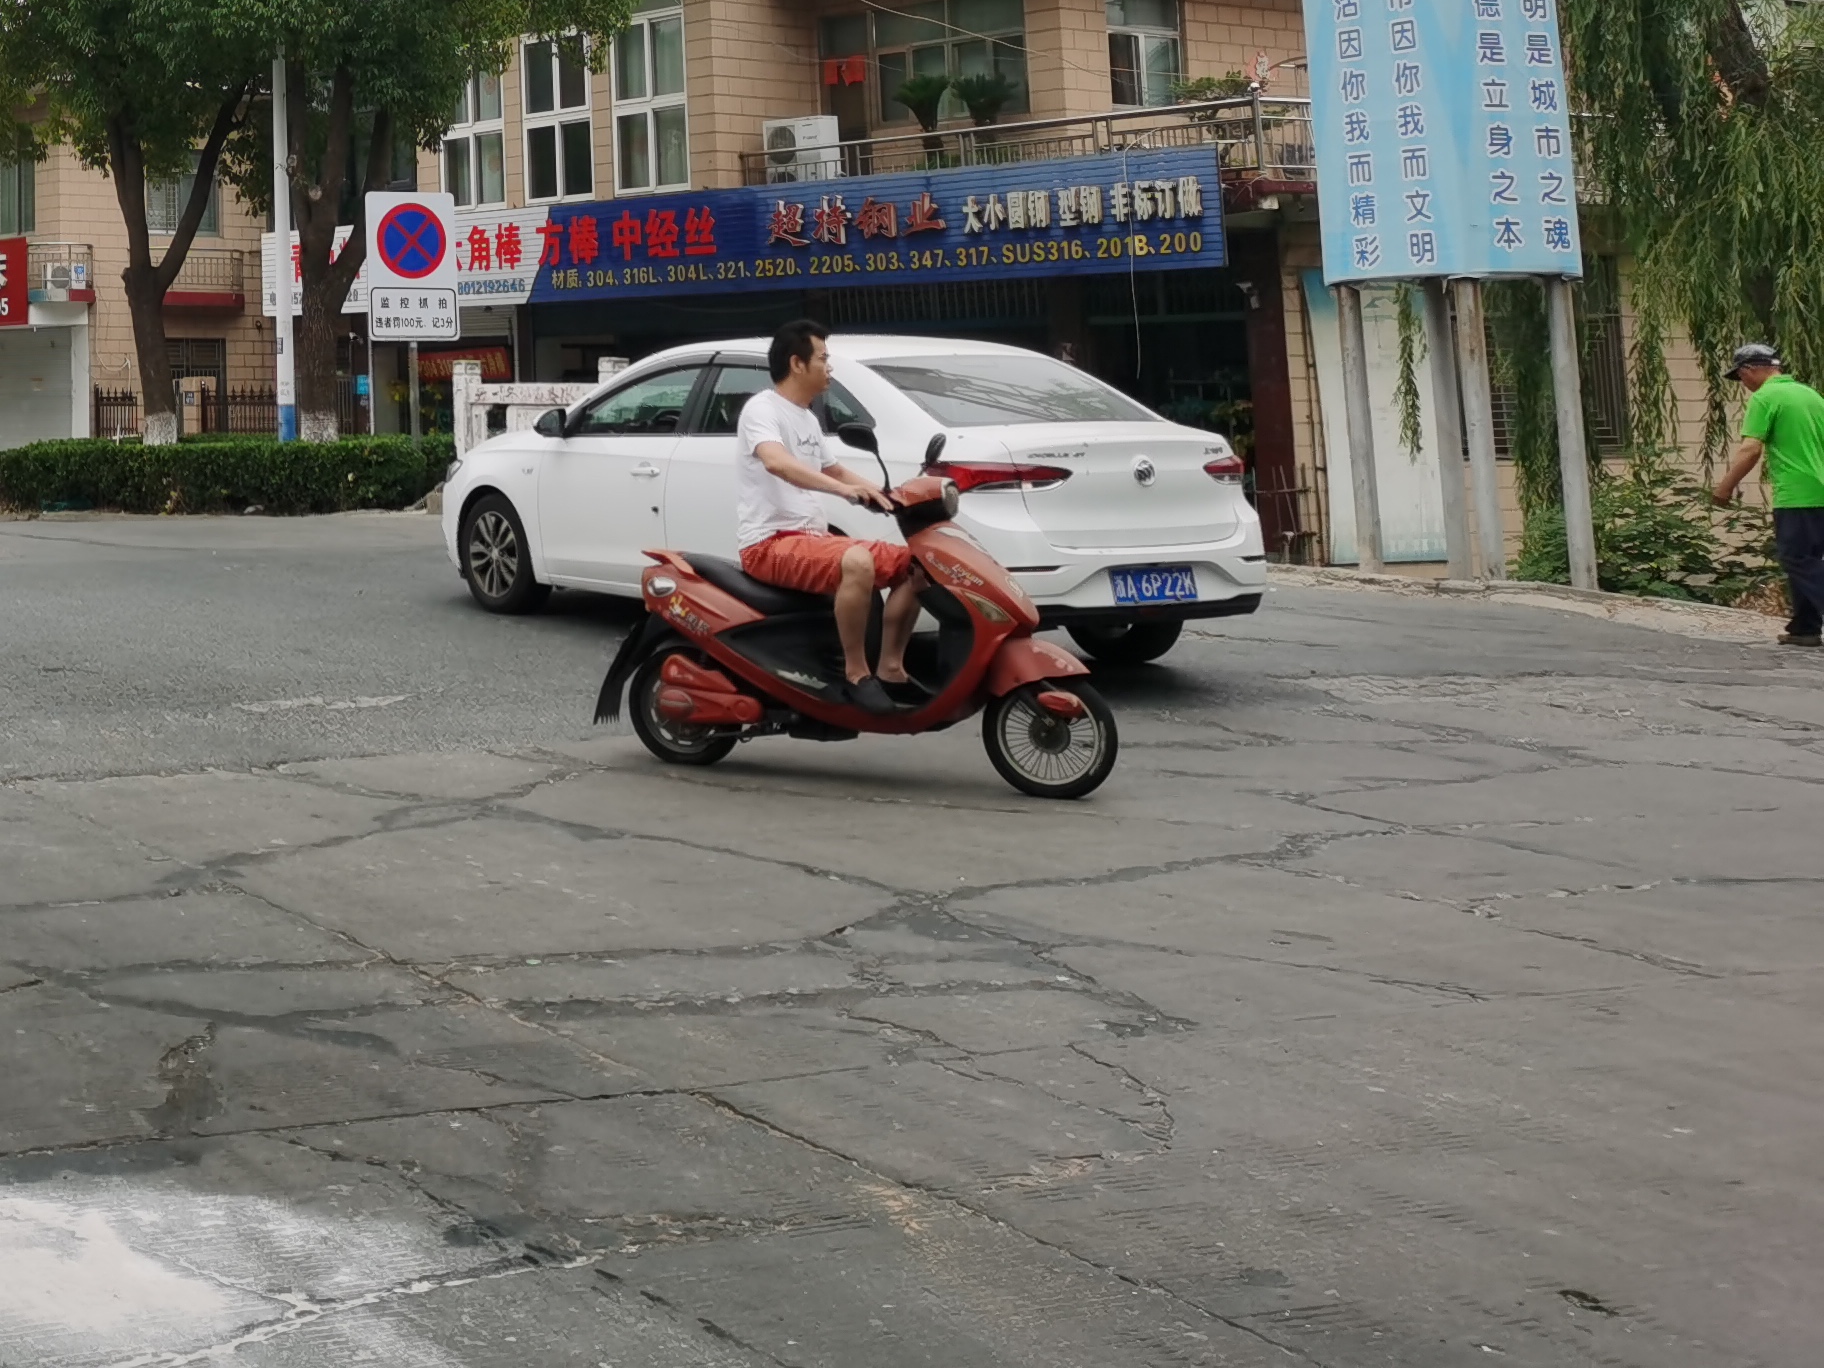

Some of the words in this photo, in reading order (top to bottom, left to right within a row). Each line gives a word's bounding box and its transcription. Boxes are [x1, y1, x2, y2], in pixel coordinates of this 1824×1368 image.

[535, 214, 599, 266] 方棒
[612, 206, 717, 261] 中经丝
[767, 191, 946, 247] 超特钢业
[962, 190, 1051, 233] 大小圆钢
[380, 296, 448, 309] 监控抓拍
